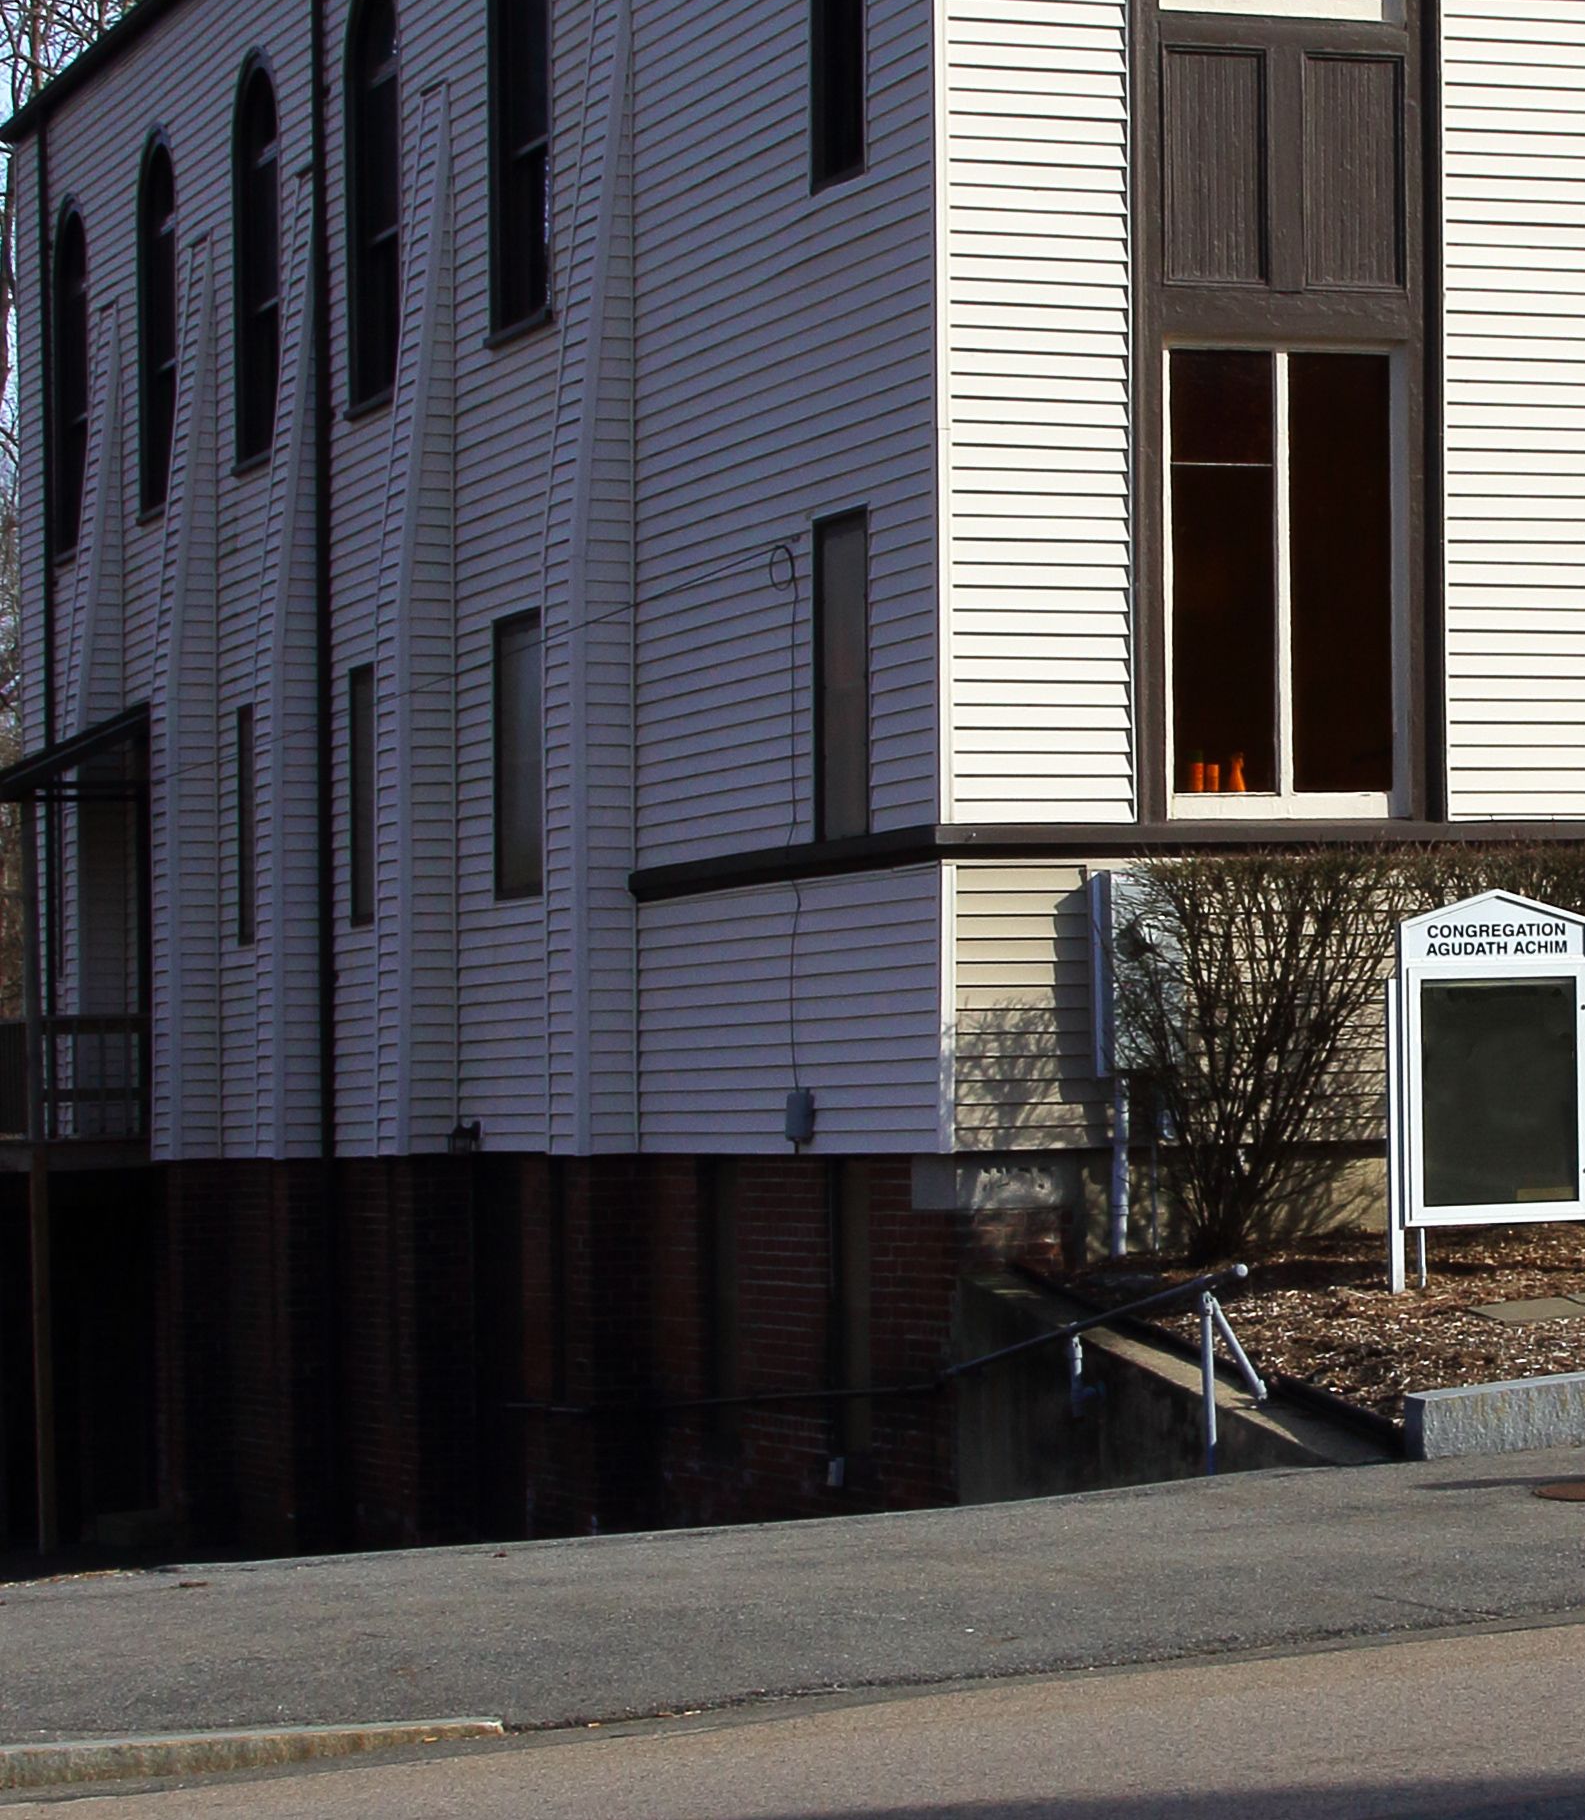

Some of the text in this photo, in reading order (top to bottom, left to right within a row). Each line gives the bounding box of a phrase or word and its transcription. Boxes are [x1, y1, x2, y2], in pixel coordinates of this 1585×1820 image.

[1427, 923, 1566, 938] CONGREGATION
[1426, 940, 1568, 956] AGUDATH ACHIM
